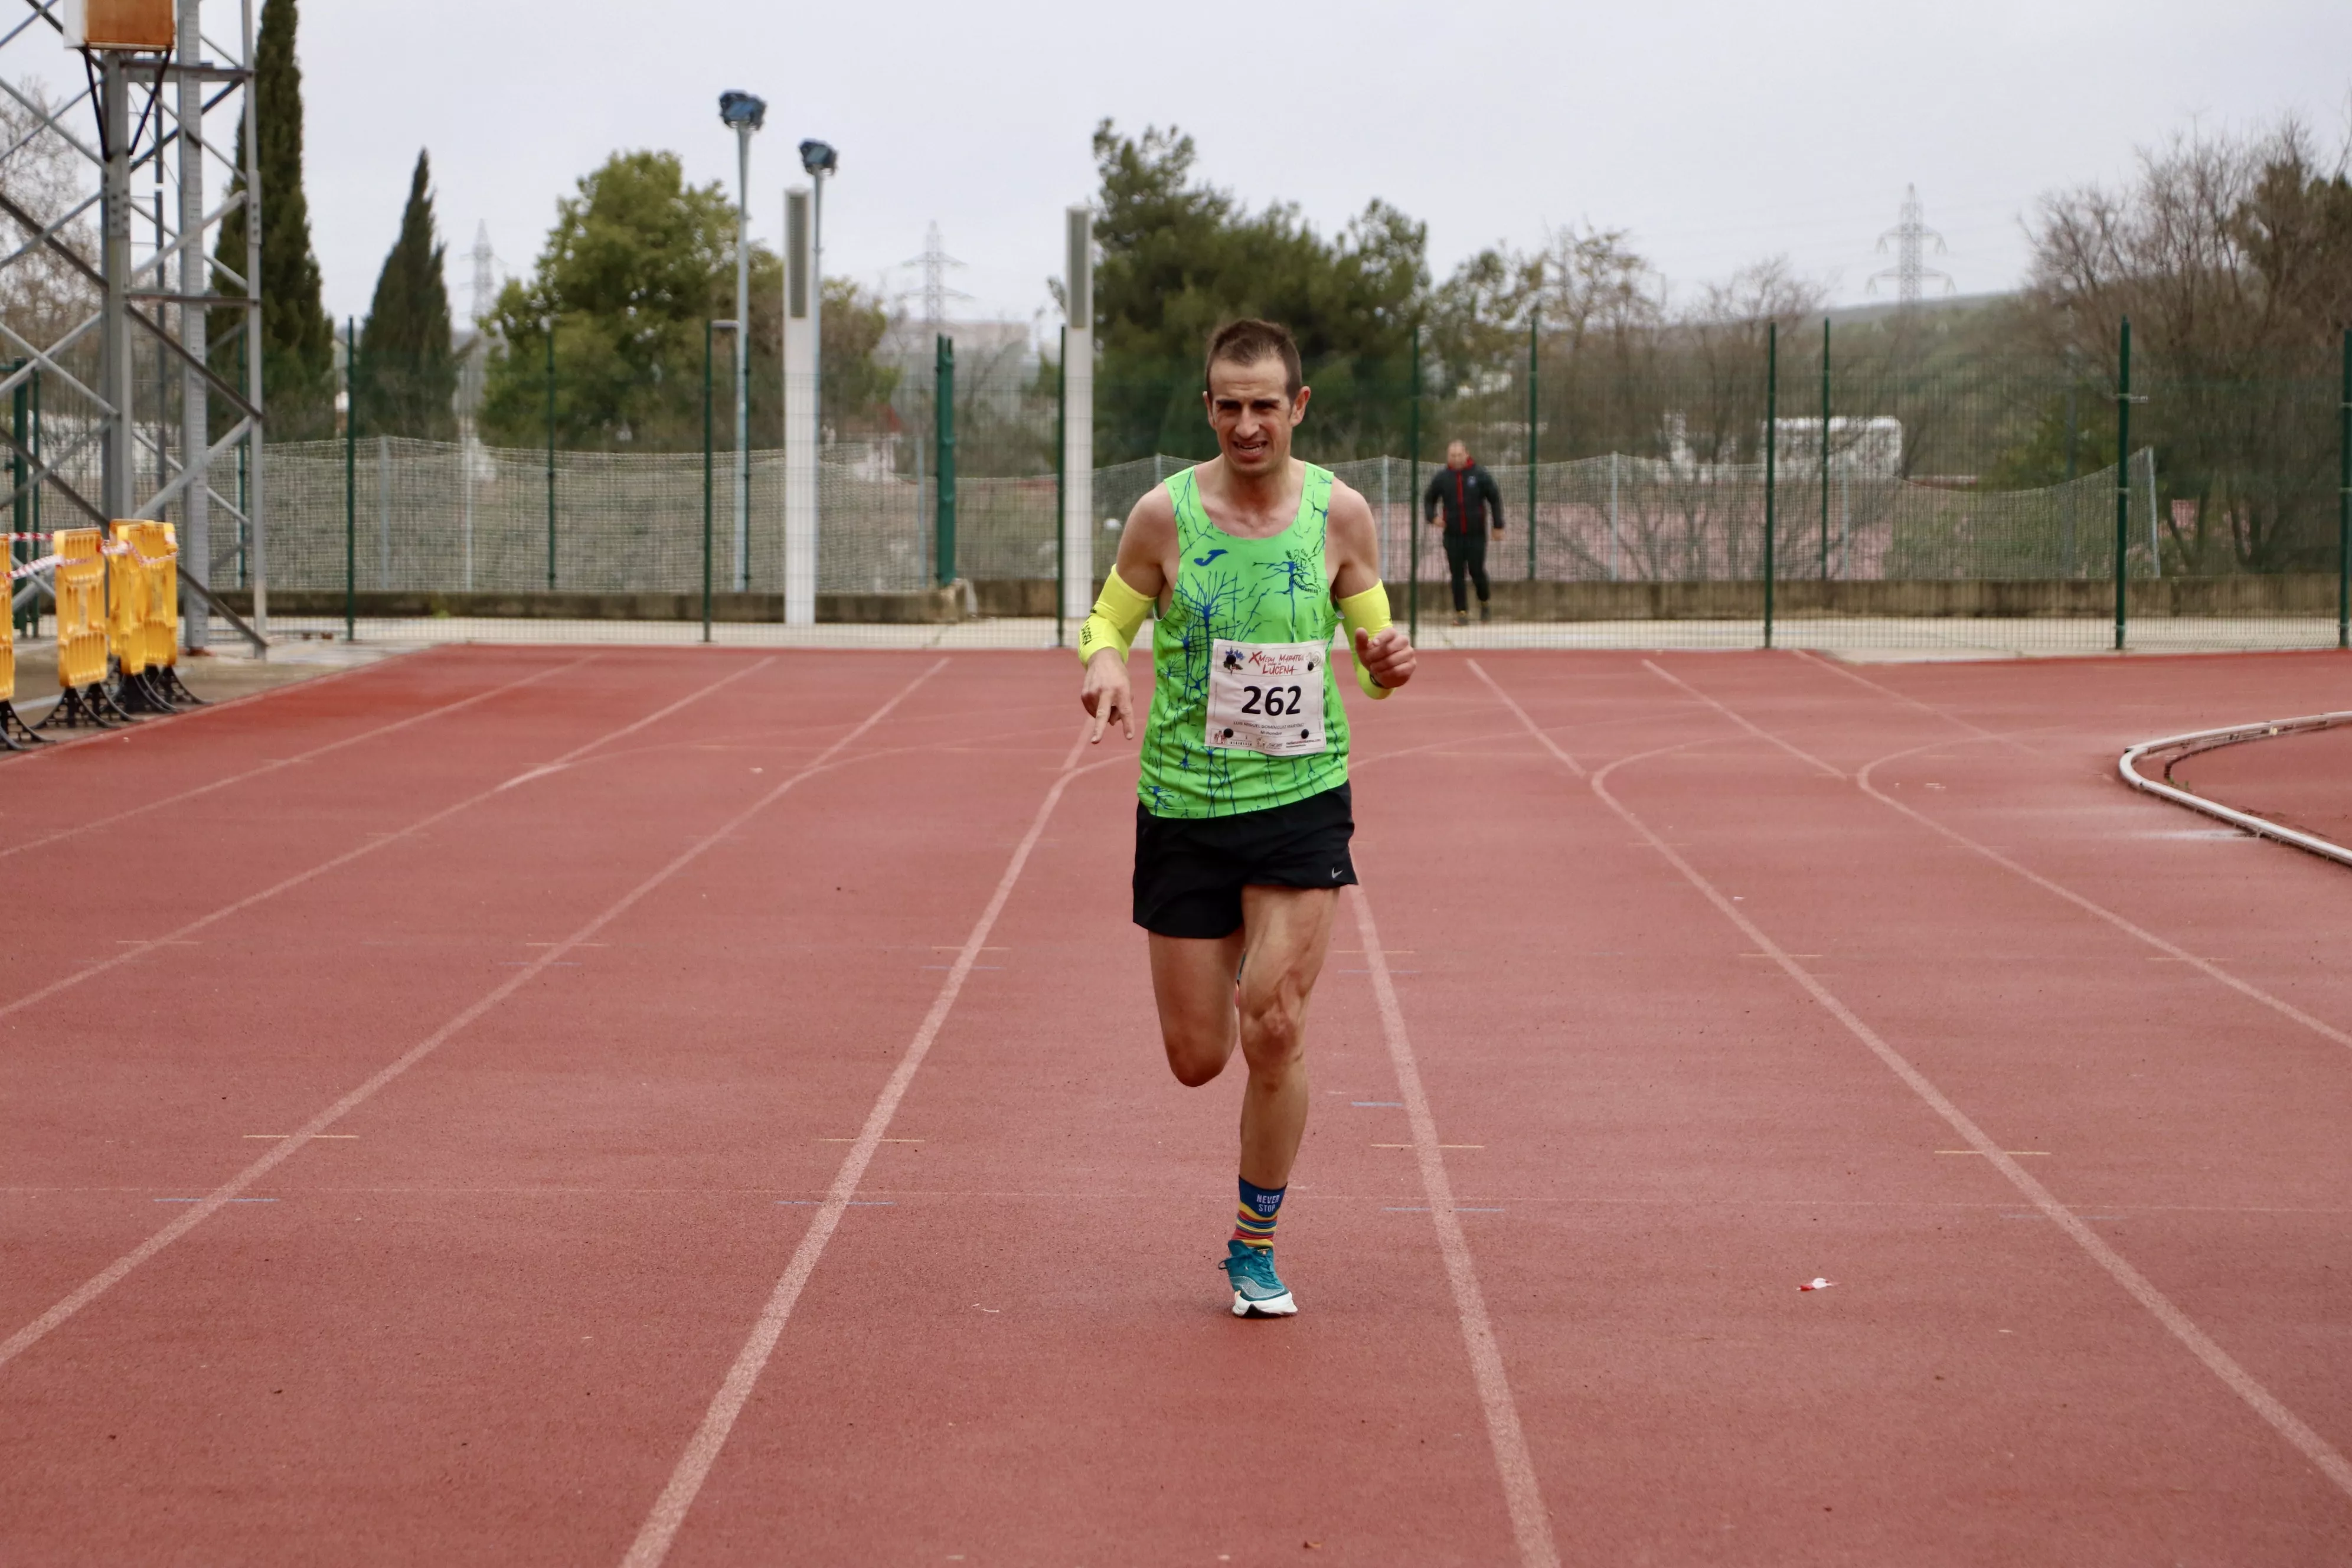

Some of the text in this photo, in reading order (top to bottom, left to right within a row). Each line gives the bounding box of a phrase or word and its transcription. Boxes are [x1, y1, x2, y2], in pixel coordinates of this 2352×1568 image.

[1262, 664, 1298, 675] LUCENA
[1242, 685, 1302, 716] 262
[1256, 1194, 1280, 1204] NEVER
[1259, 1204, 1276, 1212] STOP
